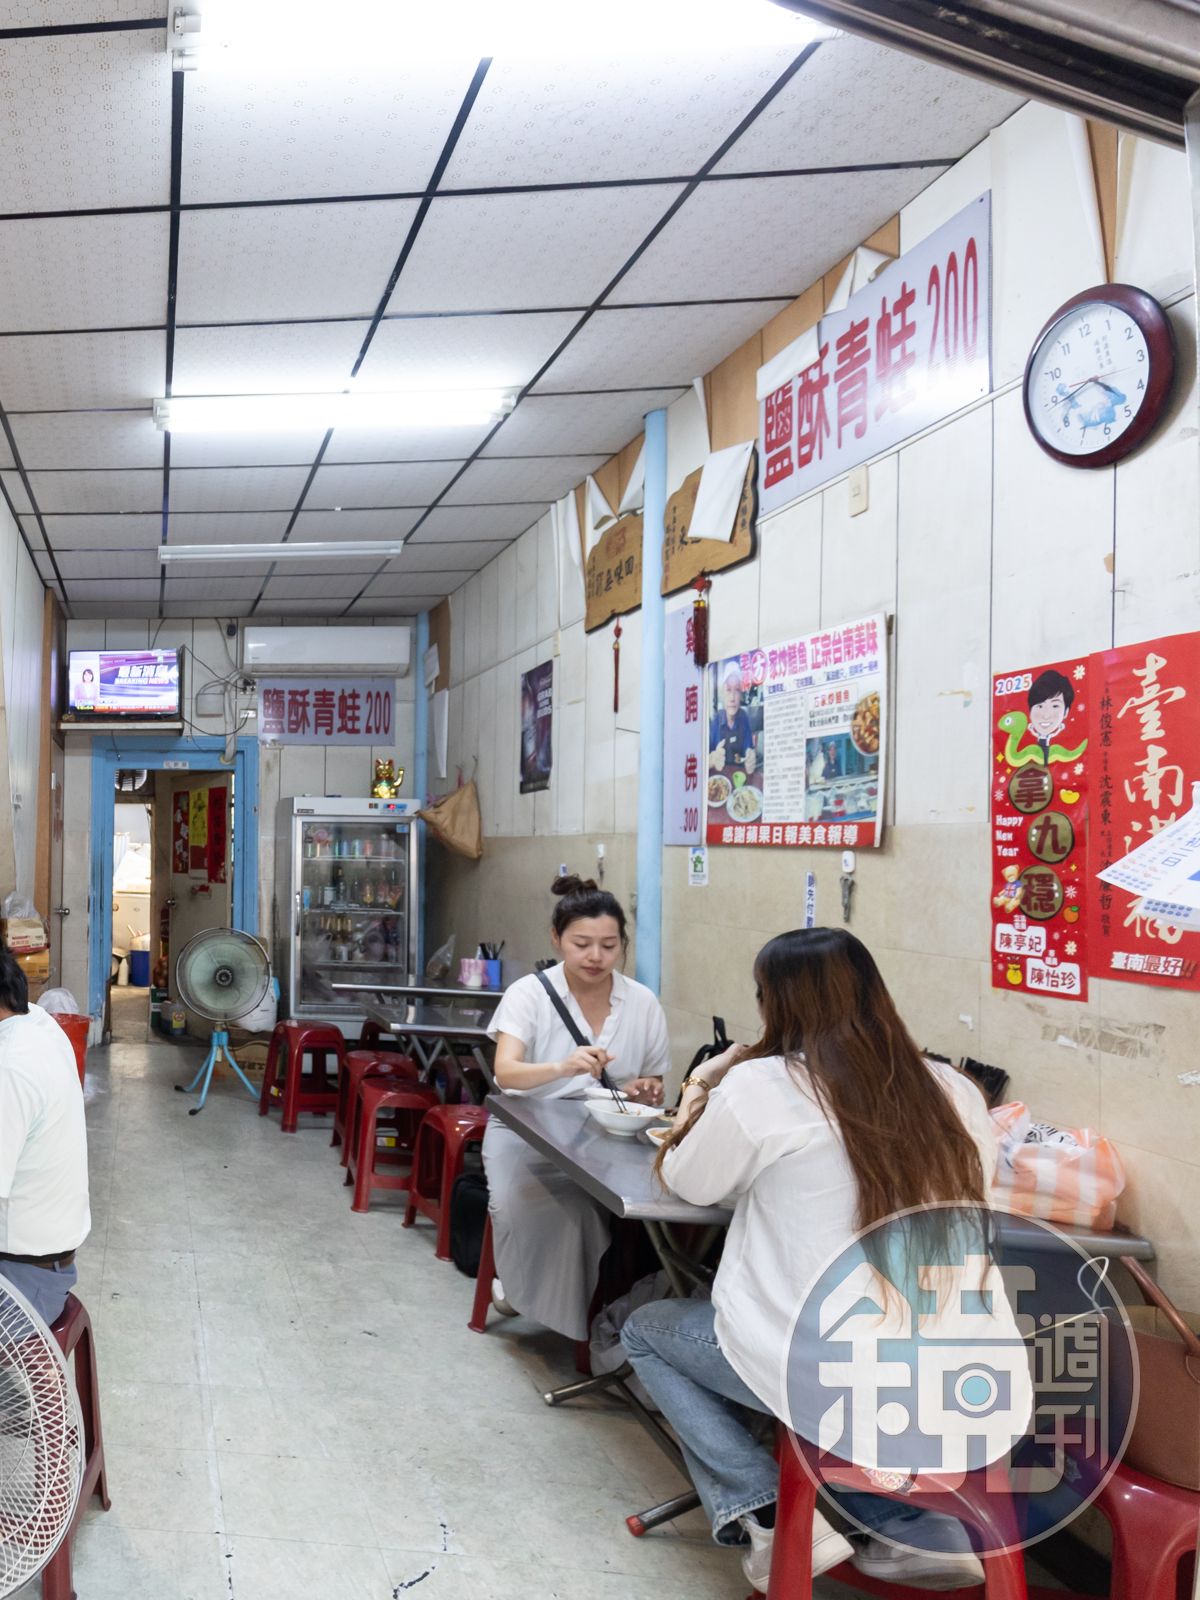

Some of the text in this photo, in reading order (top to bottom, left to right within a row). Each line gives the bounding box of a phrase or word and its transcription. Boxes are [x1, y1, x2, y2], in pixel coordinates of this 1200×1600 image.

[1079, 323, 1091, 338] 12
[1106, 320, 1111, 330] 1
[1125, 327, 1134, 340] 2
[1061, 343, 1071, 356] 11
[1137, 349, 1145, 362] 3
[1050, 367, 1062, 380] 10
[1137, 379, 1145, 390] 4
[1124, 406, 1132, 417] 5
[1063, 416, 1070, 428] 8
[1104, 422, 1111, 435] 6
[1080, 426, 1086, 439] 7
[810, 621, 878, 670] 正宗台南美味
[996, 675, 1032, 695] 2025
[262, 688, 392, 737] 鹽酥青蛙200
[684, 808, 698, 832] 300
[996, 815, 1023, 827] Happy
[997, 845, 1019, 856] Year
[1000, 933, 1042, 953] 陳亭妃
[1031, 967, 1076, 990] 陳怡珍
